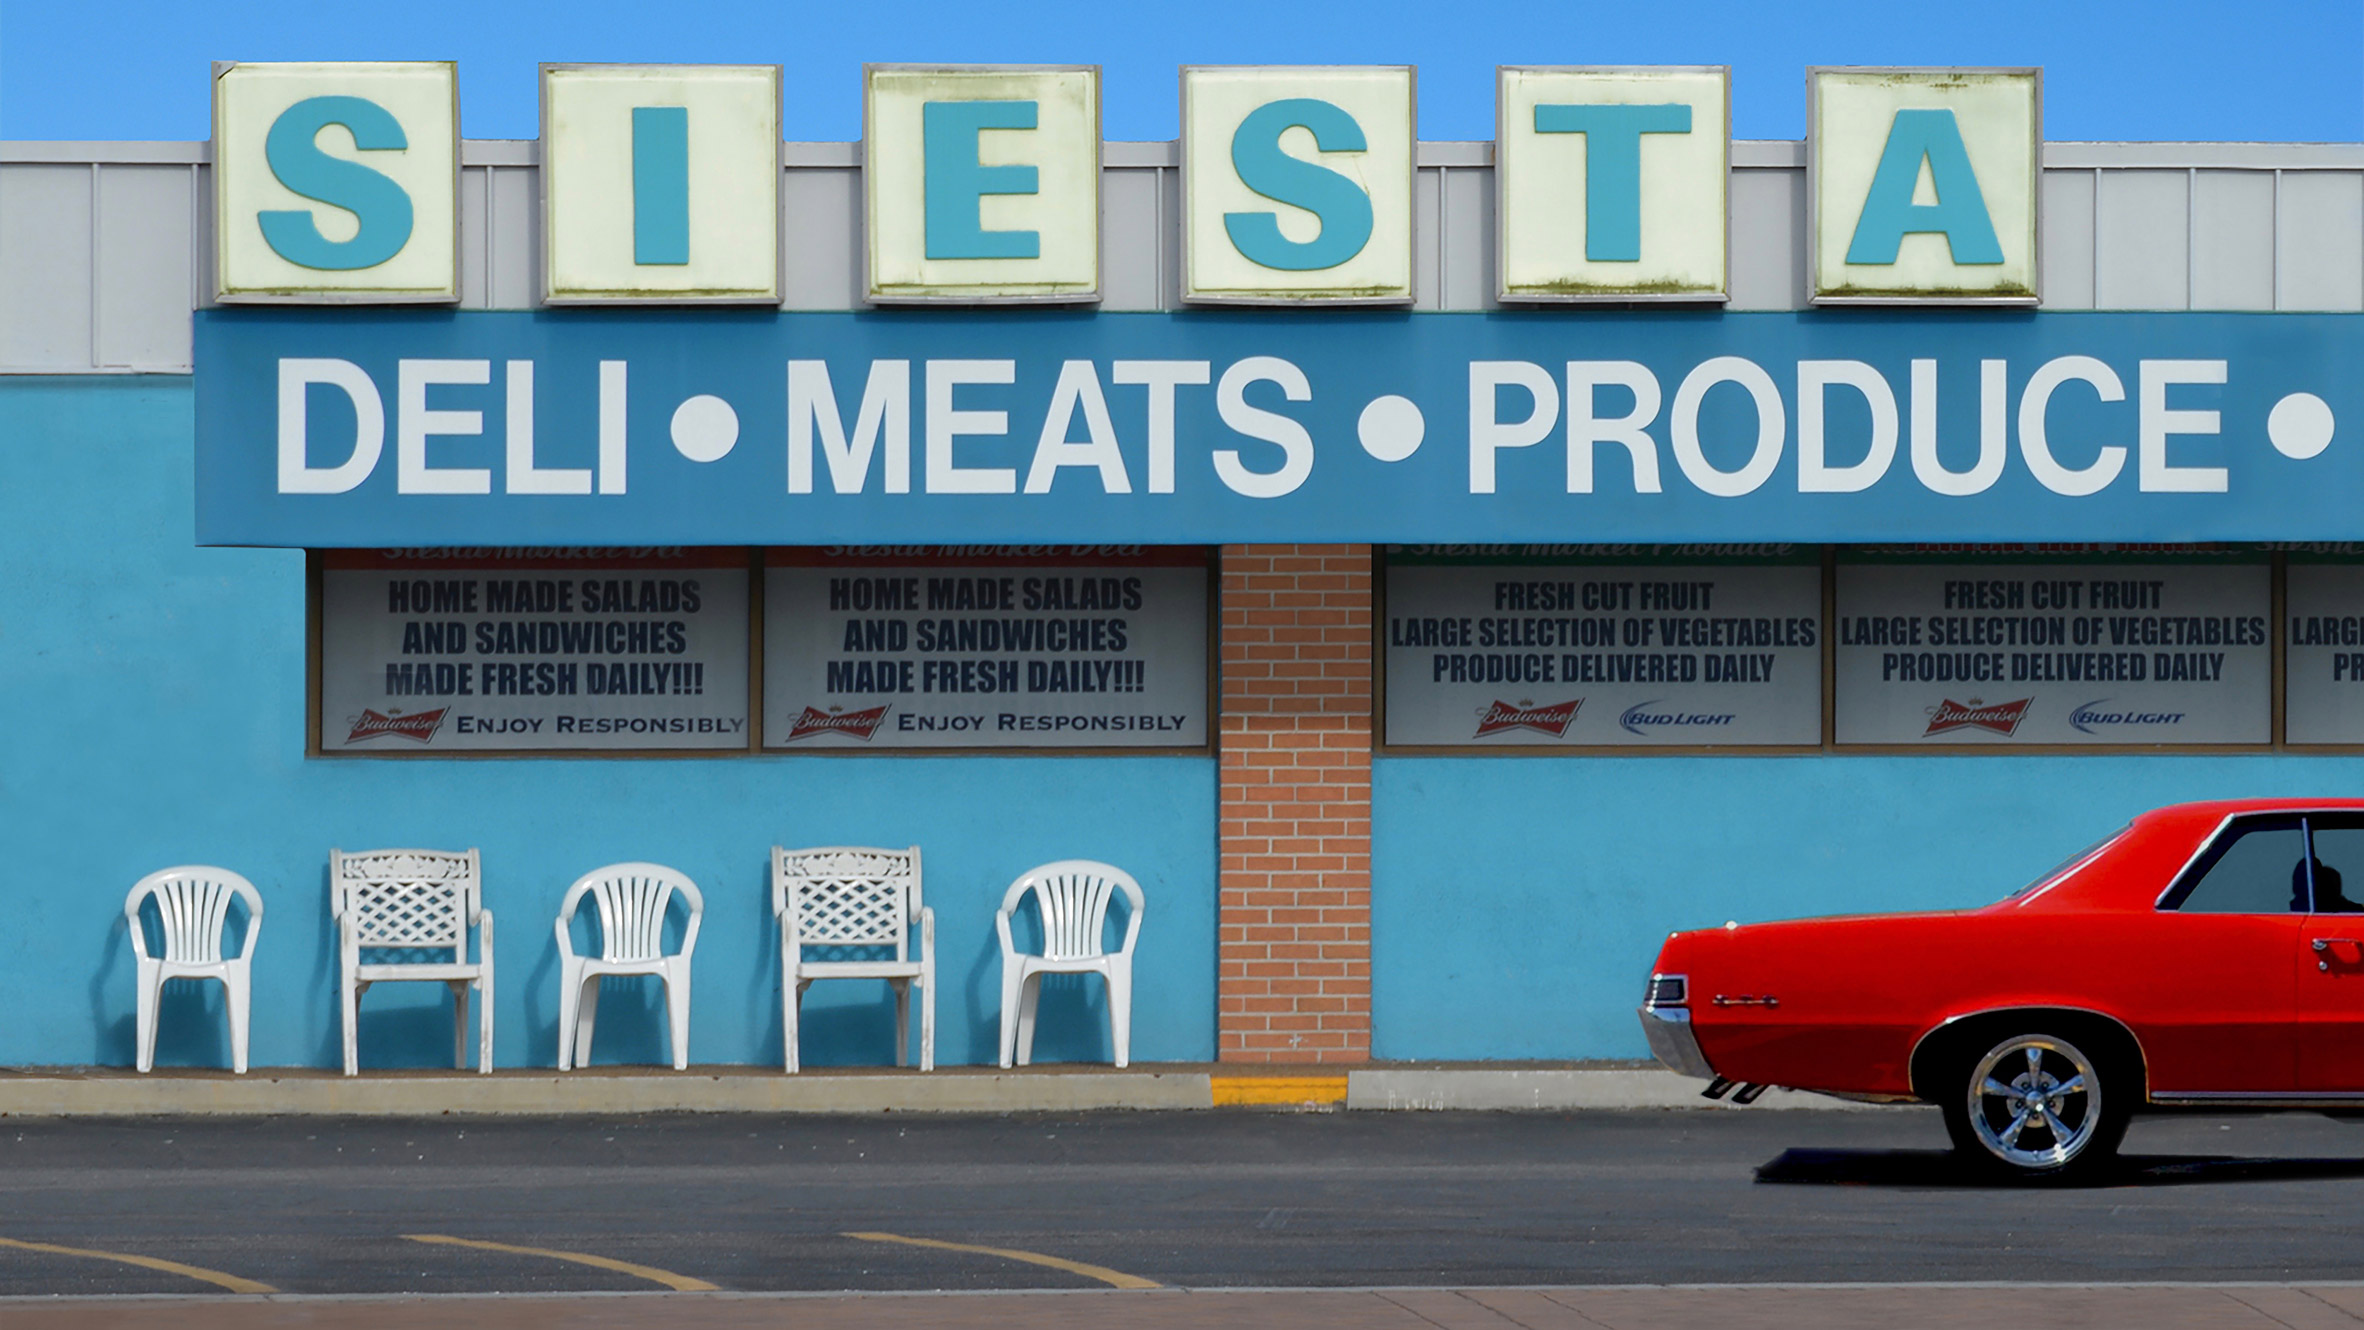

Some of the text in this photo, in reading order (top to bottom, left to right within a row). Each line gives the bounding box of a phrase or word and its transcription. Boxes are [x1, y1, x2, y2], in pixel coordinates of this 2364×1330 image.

[259, 96, 2005, 270] SIESTA
[278, 356, 2228, 497] DELI MEATS PRODUCE
[390, 581, 701, 614] HOME MADE SALADS
[831, 578, 1143, 612] HOME MADE SALADS
[1496, 582, 1715, 612] FRESH CUT FRUIT
[1946, 581, 2165, 611] FRESH CUT FRUIT
[404, 622, 686, 655] AND SANDWICHES
[845, 619, 1128, 653] AND SANDWICHES
[1393, 619, 1816, 648] LARGE SELECTION OF VEGETABLES
[1843, 617, 2266, 647] LARGE SELECTION OF VEGETABLES
[2294, 617, 2364, 647] LARG
[388, 664, 704, 696] MADE FRESH DAILY!!!
[829, 661, 1145, 694] MADE FRESH DAILY!!!
[1435, 655, 1775, 684] PRODUCE DELIVERED DAILY
[1884, 654, 2225, 683] PRODUCE DELIVERED DAILY
[348, 713, 443, 732] Budweiser
[459, 717, 743, 734] ENJOY RESPONSIBLY
[788, 711, 884, 730] Budweiser
[900, 714, 1186, 732] ENJOY RESPONSIBLY
[1476, 706, 1577, 724] Budweiser
[1629, 714, 1735, 726] BUD LIGHT
[1925, 705, 2027, 723] Budweiser
[2078, 712, 2185, 725] BUD LIGHT
